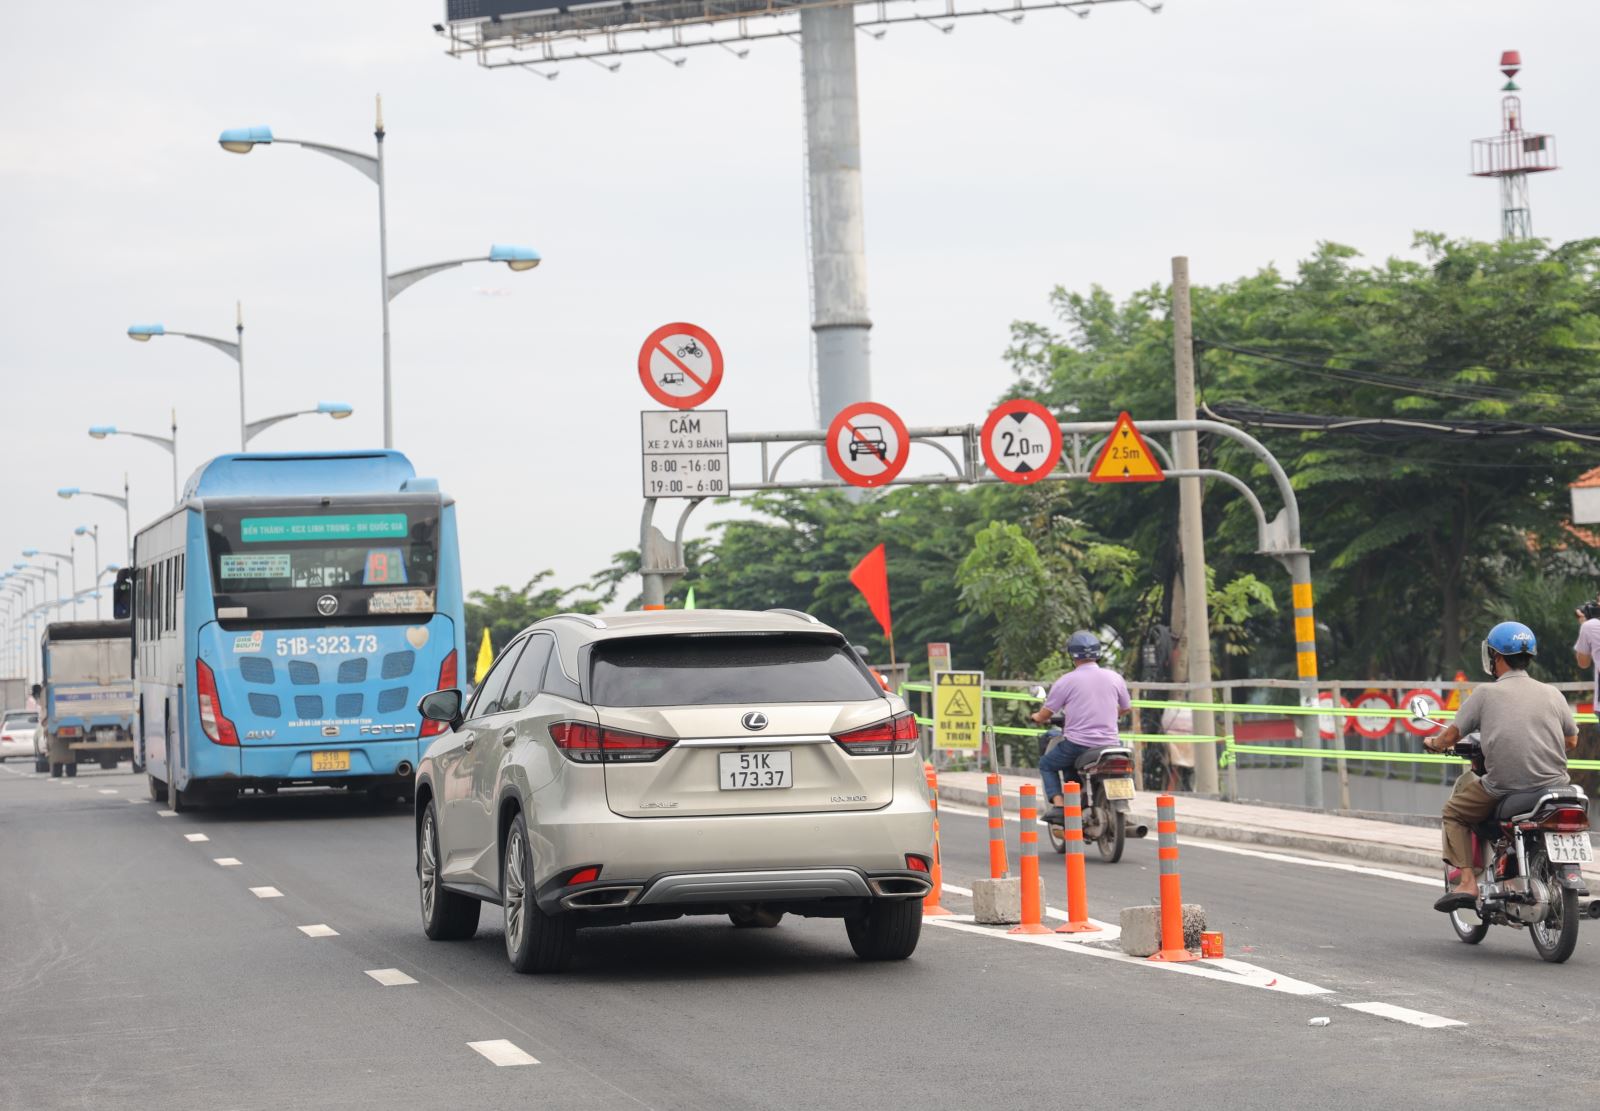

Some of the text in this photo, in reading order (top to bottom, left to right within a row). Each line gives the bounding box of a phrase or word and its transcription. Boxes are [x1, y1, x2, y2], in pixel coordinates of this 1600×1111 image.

[670, 414, 701, 434] CẤM
[648, 440, 660, 449] XE
[664, 440, 669, 449] 2
[672, 438, 685, 448] VÀ
[688, 439, 693, 448] 3
[1112, 447, 1140, 460] 2.5m
[651, 460, 677, 472] 8:00
[651, 480, 683, 493] 19:00
[697, 480, 723, 492] 6:00
[276, 634, 378, 656] 51B-323.73
[244, 729, 276, 740] AUV
[360, 723, 416, 735] FOTON
[740, 753, 771, 769] 51K
[730, 770, 784, 787] 173.37
